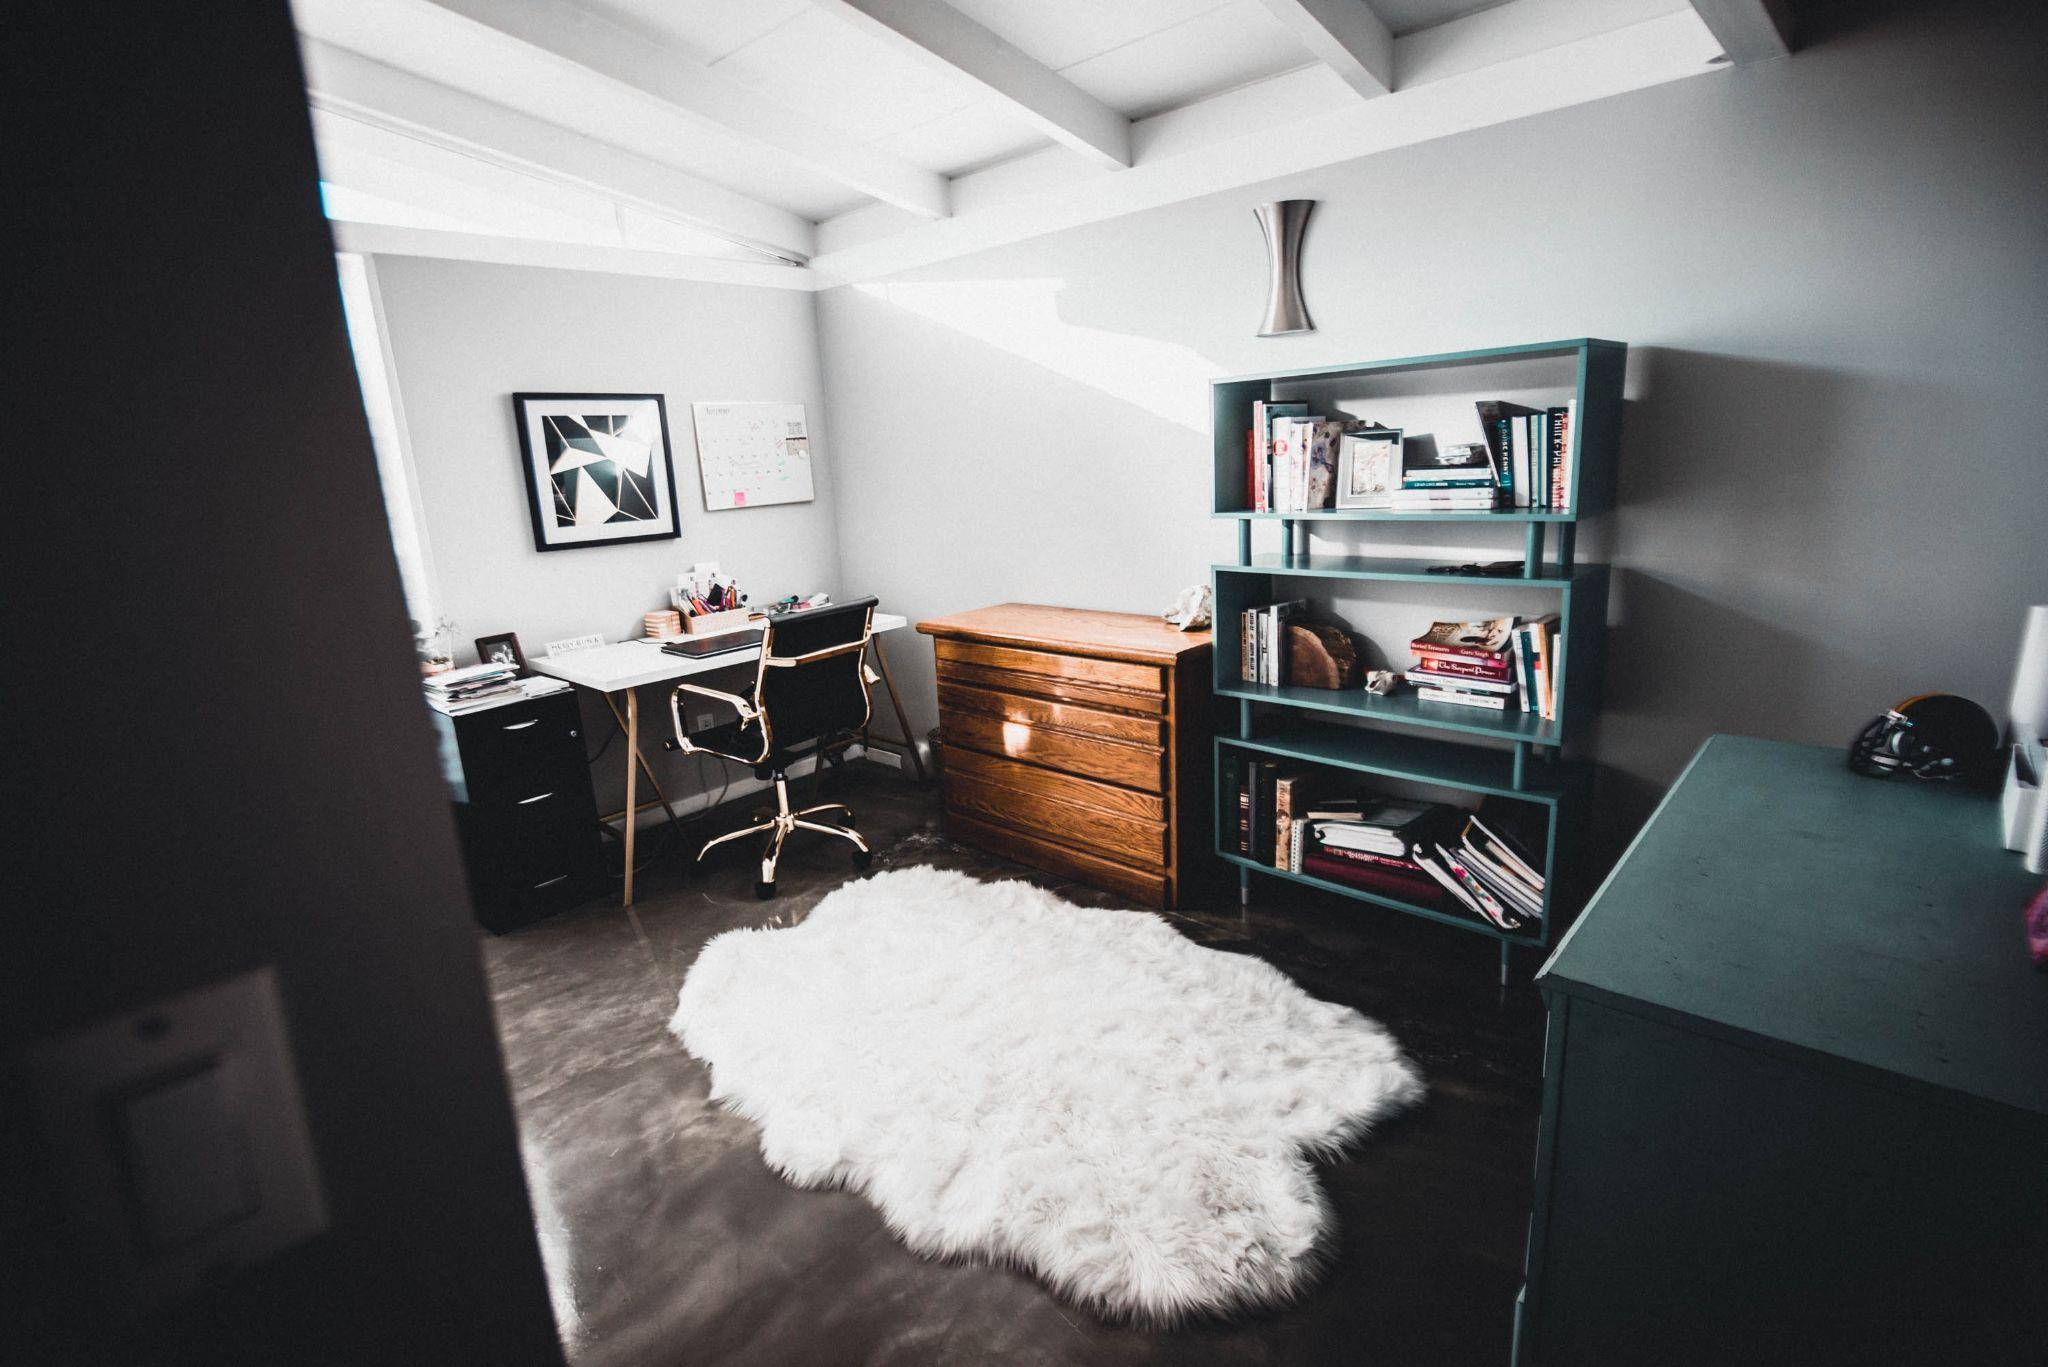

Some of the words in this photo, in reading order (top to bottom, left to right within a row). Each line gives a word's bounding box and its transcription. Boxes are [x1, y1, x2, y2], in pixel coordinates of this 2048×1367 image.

[1428, 643, 1450, 652] Treasures
[1474, 650, 1489, 658] Singh
[1439, 661, 1450, 670] The
[1451, 664, 1475, 673] Serpent
[1475, 666, 1496, 676] Power
